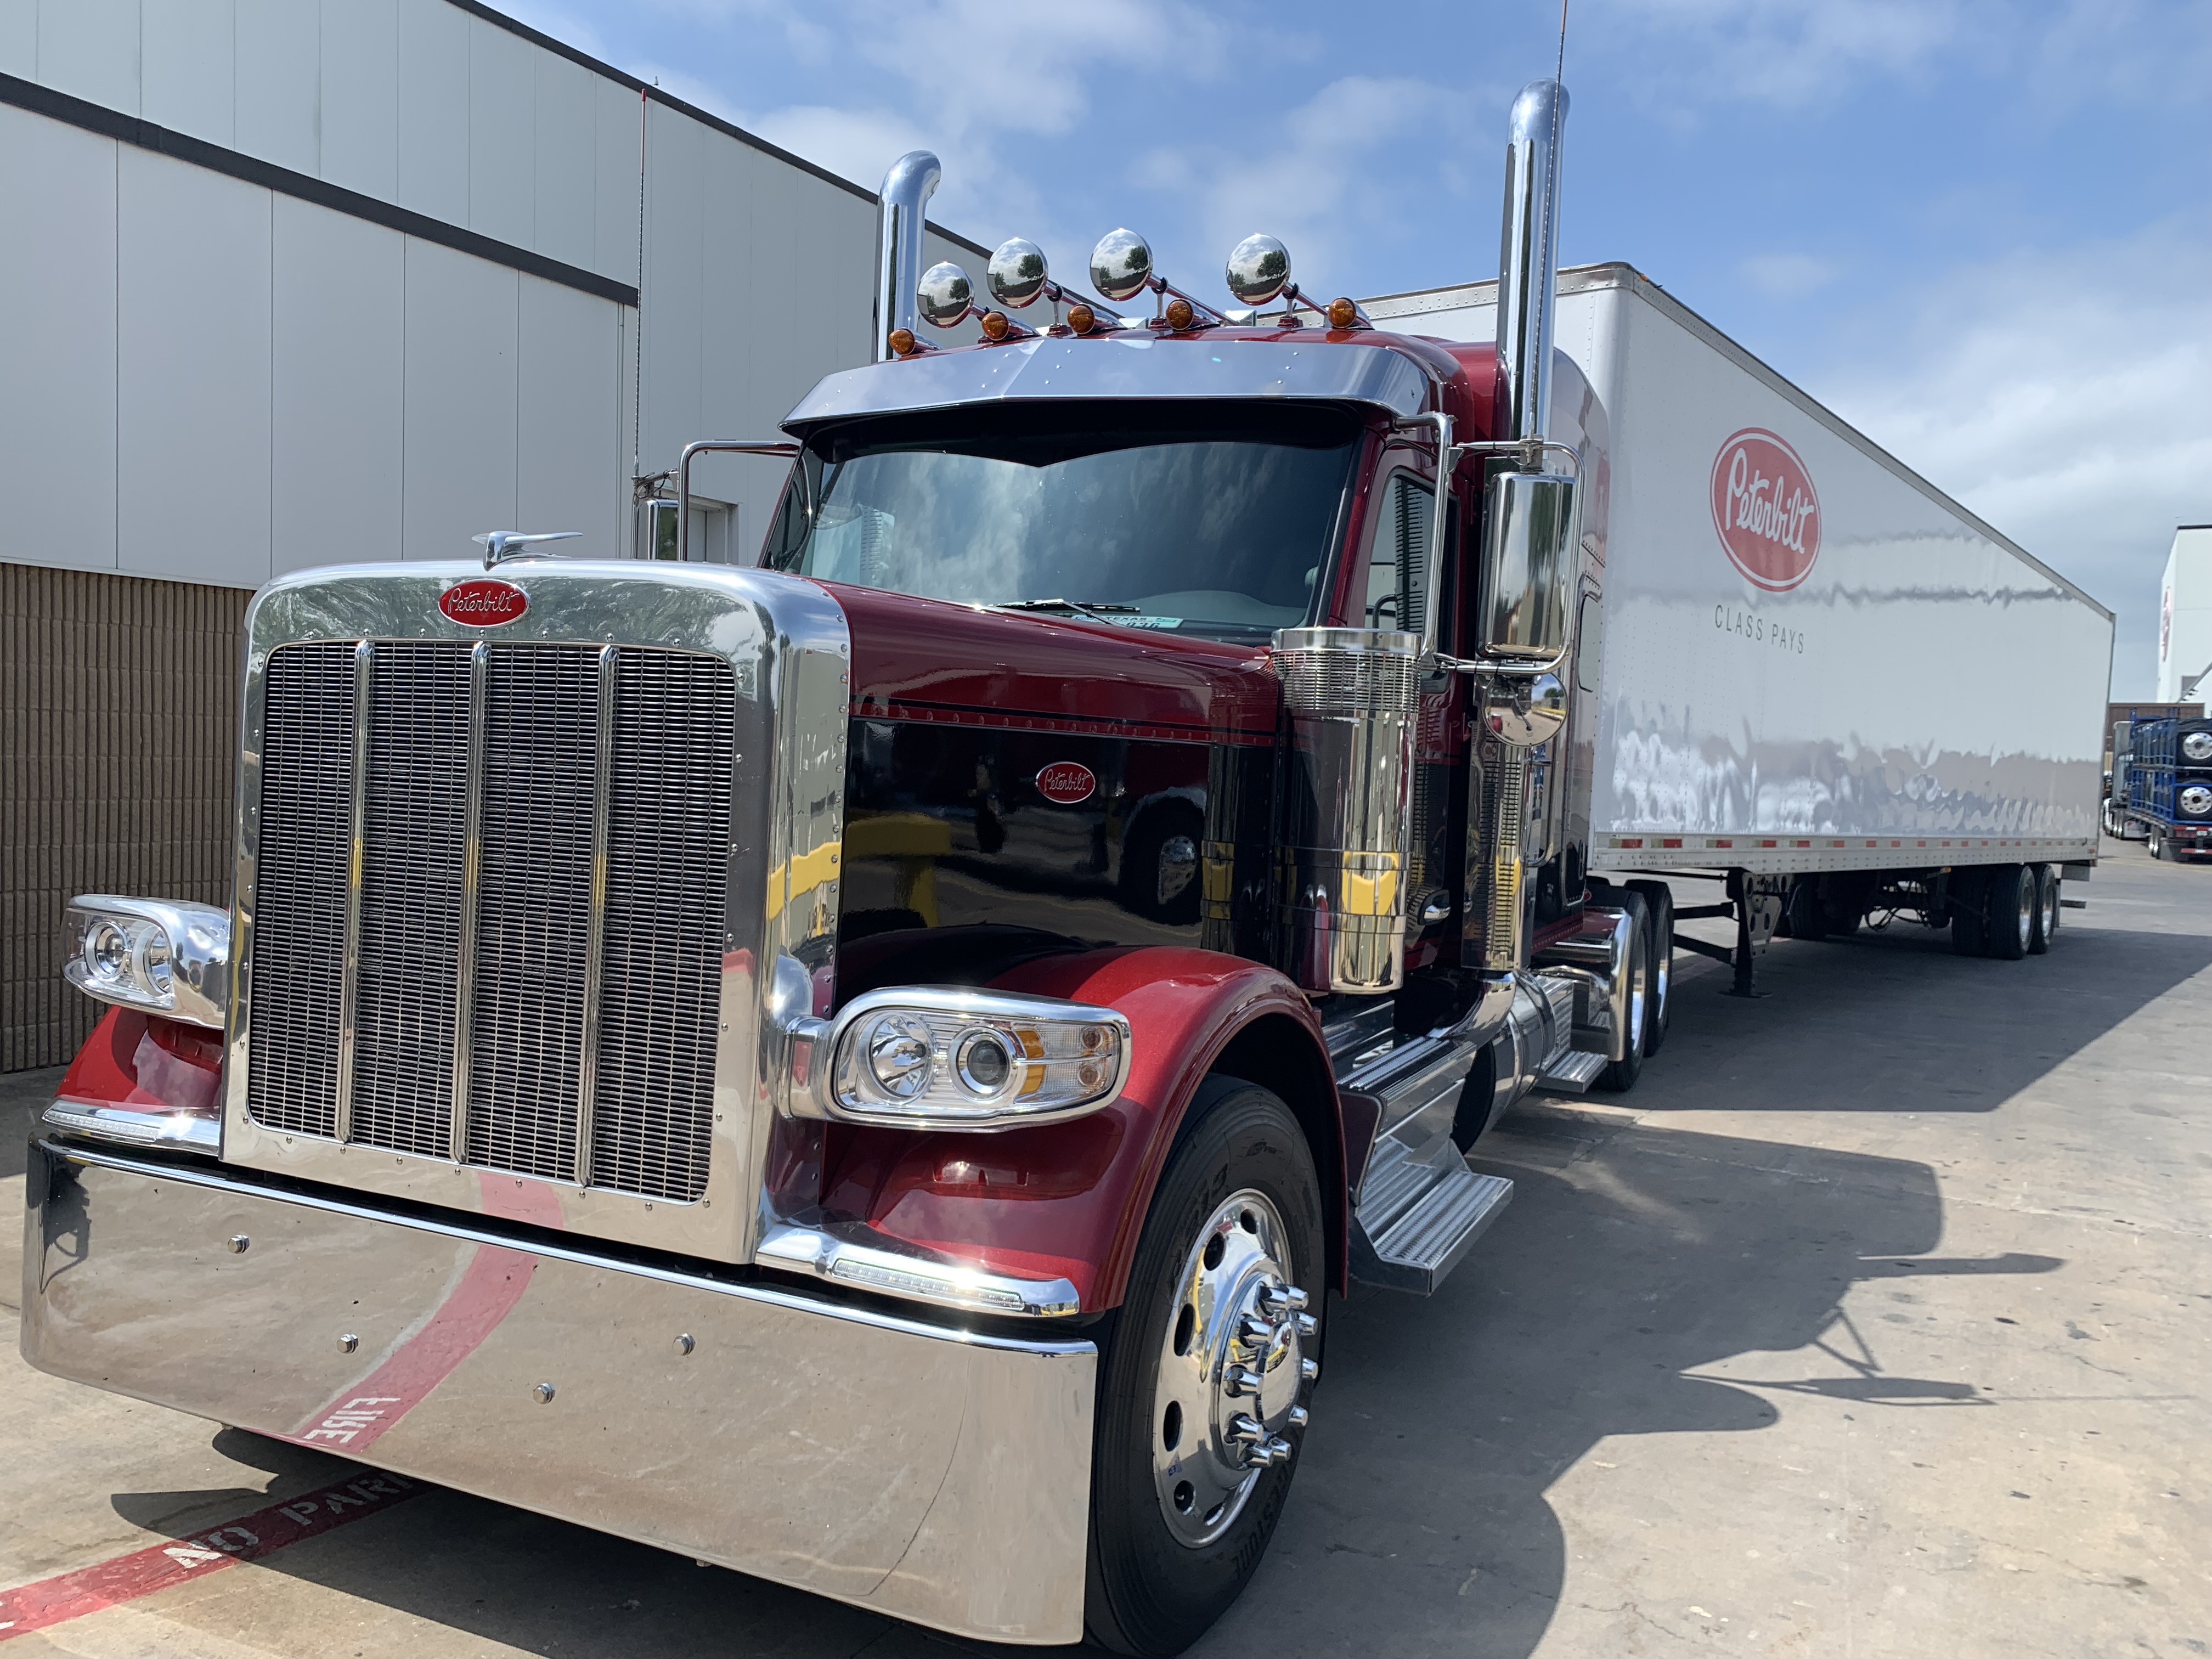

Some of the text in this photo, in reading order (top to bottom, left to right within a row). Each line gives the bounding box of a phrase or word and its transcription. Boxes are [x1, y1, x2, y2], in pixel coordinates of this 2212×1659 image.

[1725, 448, 1814, 554] Peterbilt
[448, 588, 520, 614] Peterbilt
[1715, 604, 1804, 654] CLASS PAYS
[1045, 769, 1091, 792] Peterbilt
[162, 1526, 258, 1568] NO
